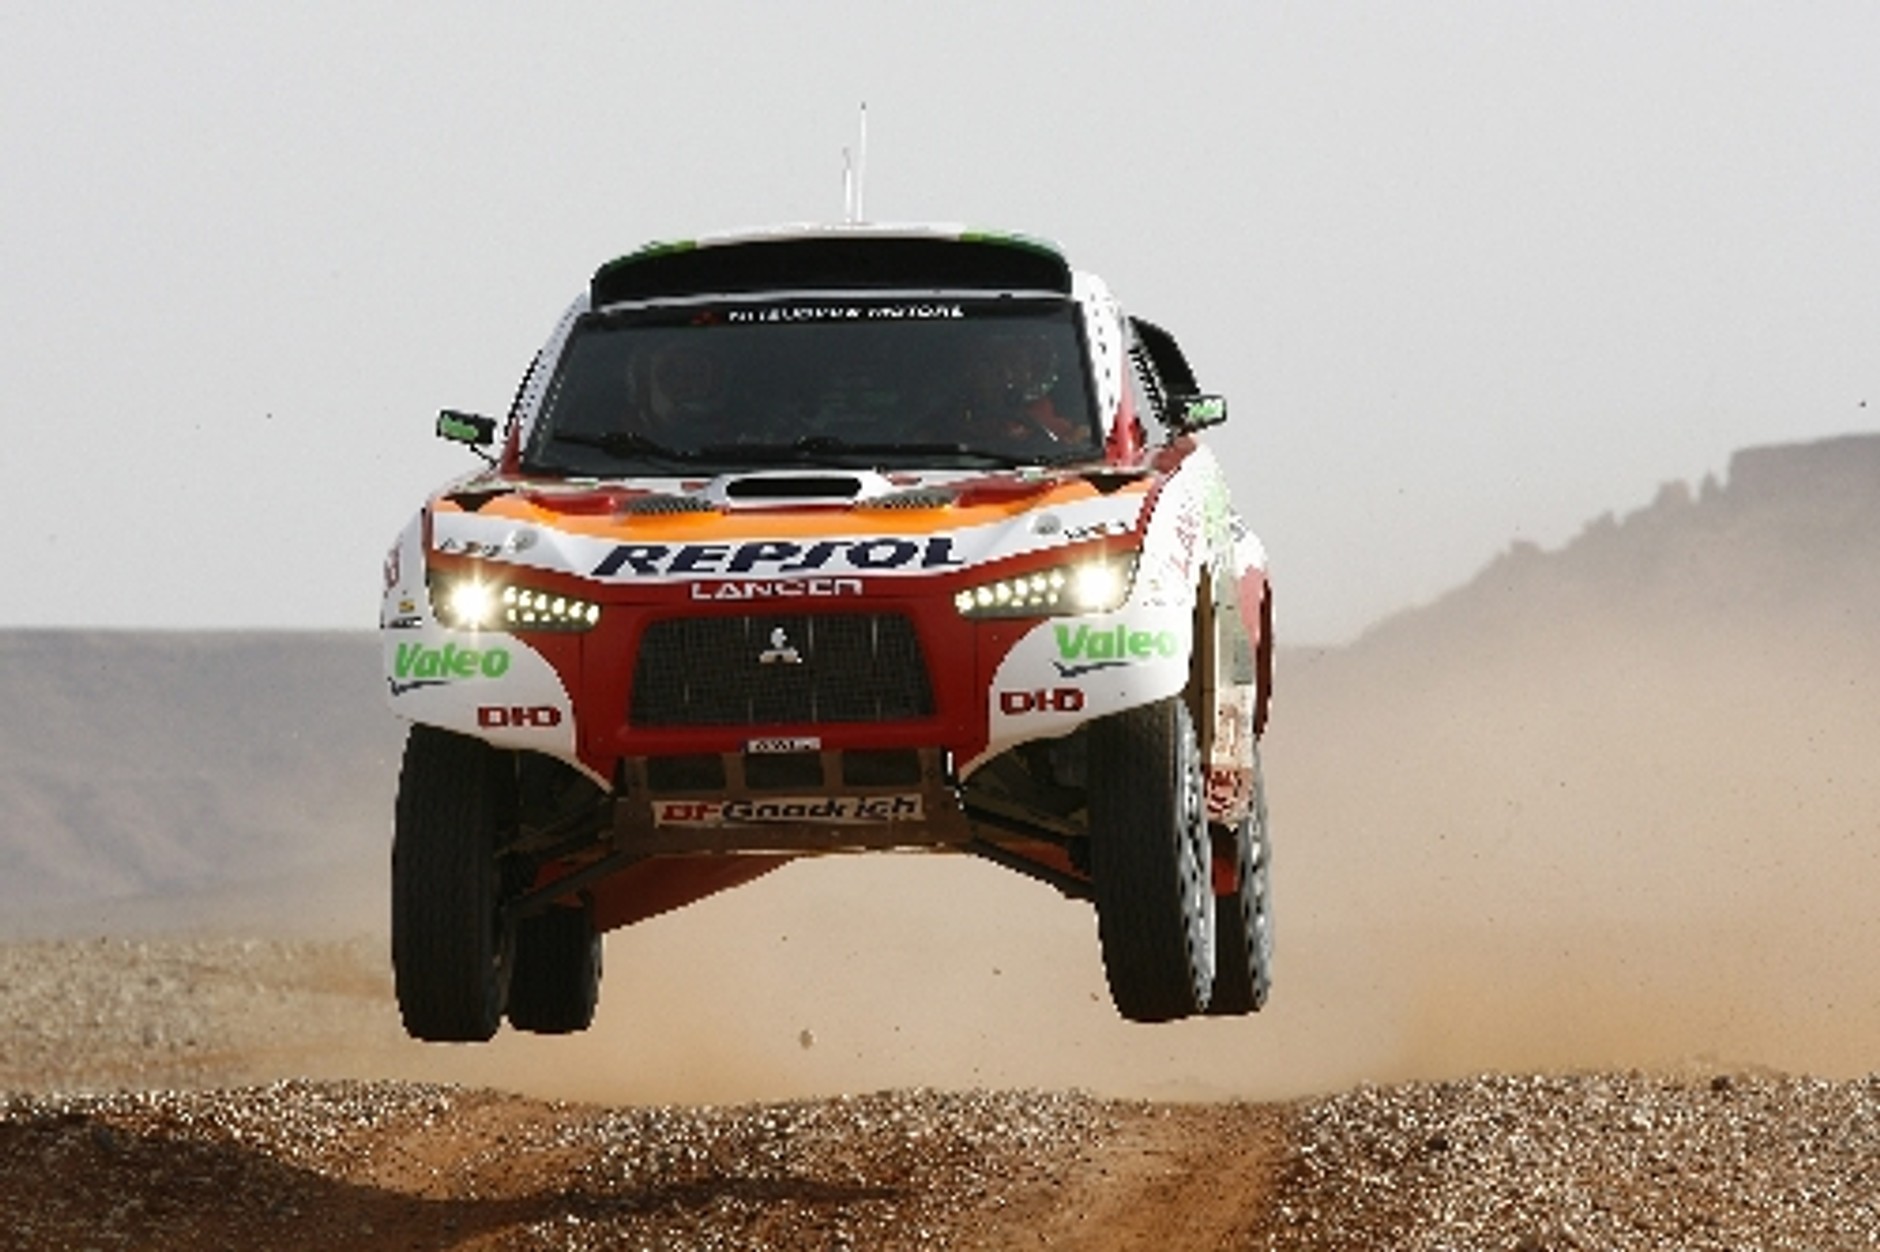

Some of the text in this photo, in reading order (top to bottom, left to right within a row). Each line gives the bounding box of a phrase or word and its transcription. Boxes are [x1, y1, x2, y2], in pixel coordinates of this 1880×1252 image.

[592, 538, 963, 576] REPSOL
[692, 579, 862, 599] LANCER
[395, 640, 511, 678] Valeo
[1054, 624, 1179, 660] Valeo
